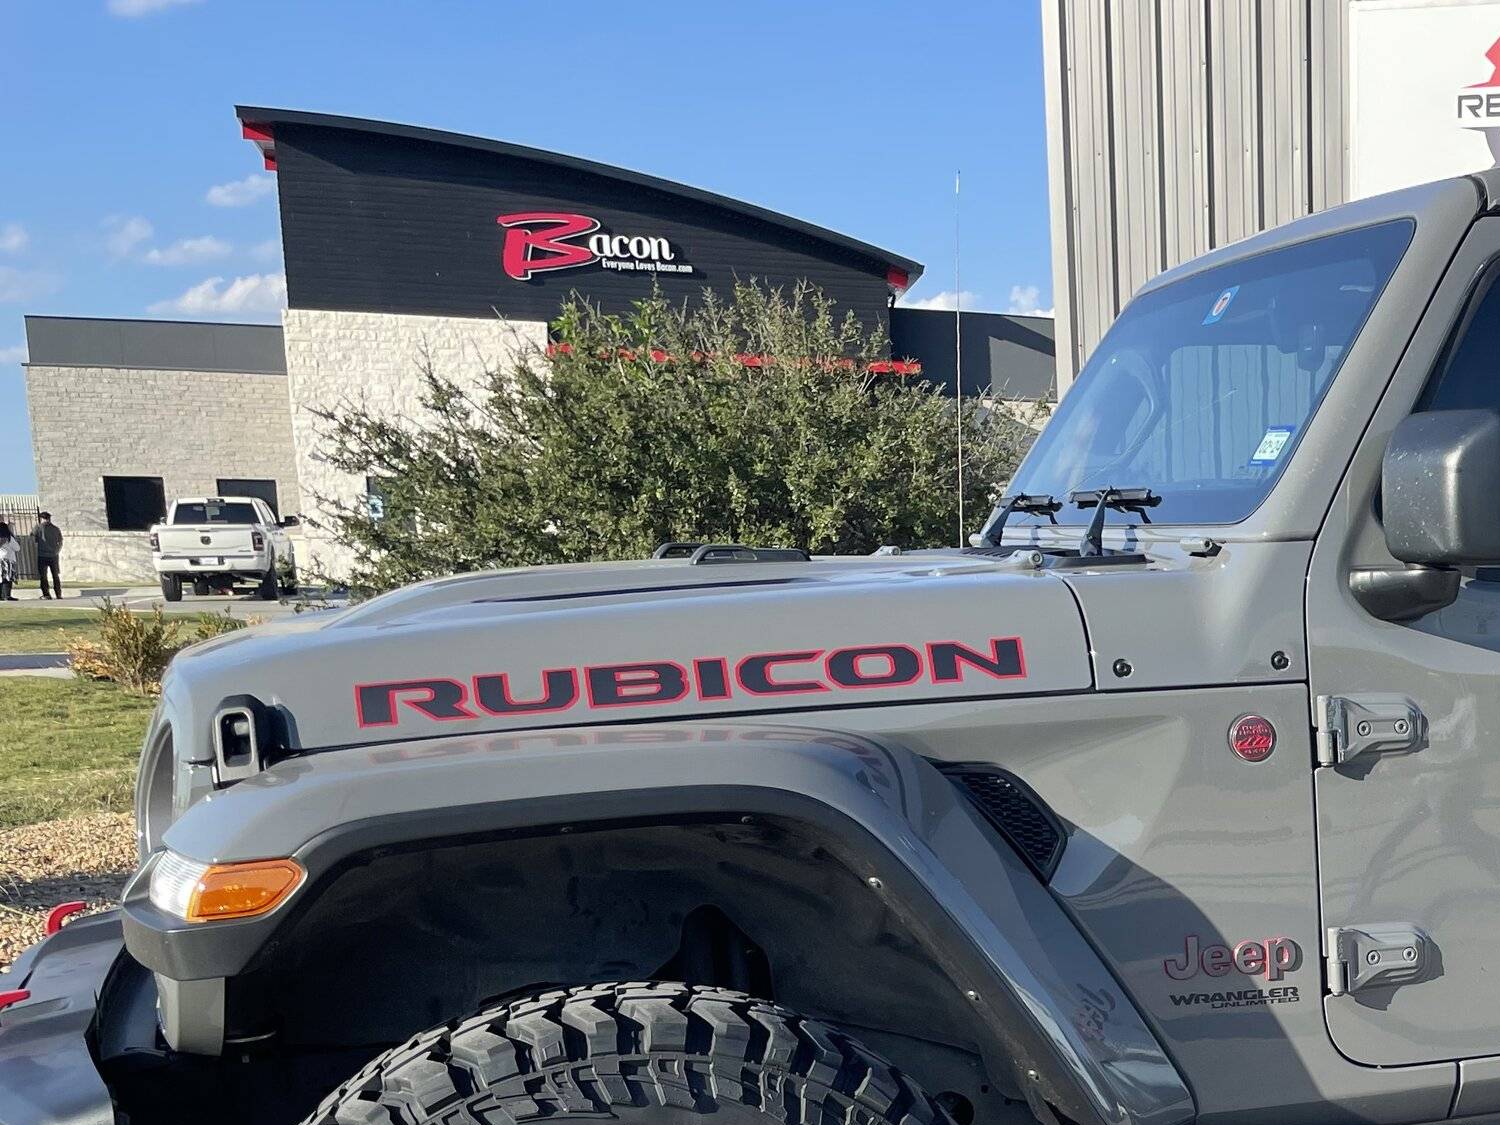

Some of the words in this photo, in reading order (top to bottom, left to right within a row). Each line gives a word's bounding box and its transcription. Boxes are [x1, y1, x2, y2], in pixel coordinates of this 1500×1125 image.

[496, 211, 675, 281] Bacon
[602, 258, 634, 271] Everyone
[635, 260, 655, 271] Loves
[656, 261, 693, 273] Bacon.com
[355, 636, 1028, 728] RUBICON
[1164, 935, 1303, 981] Jeep
[1169, 986, 1299, 1006] WRANGLER
[1211, 997, 1300, 1009] UNLIMITED
